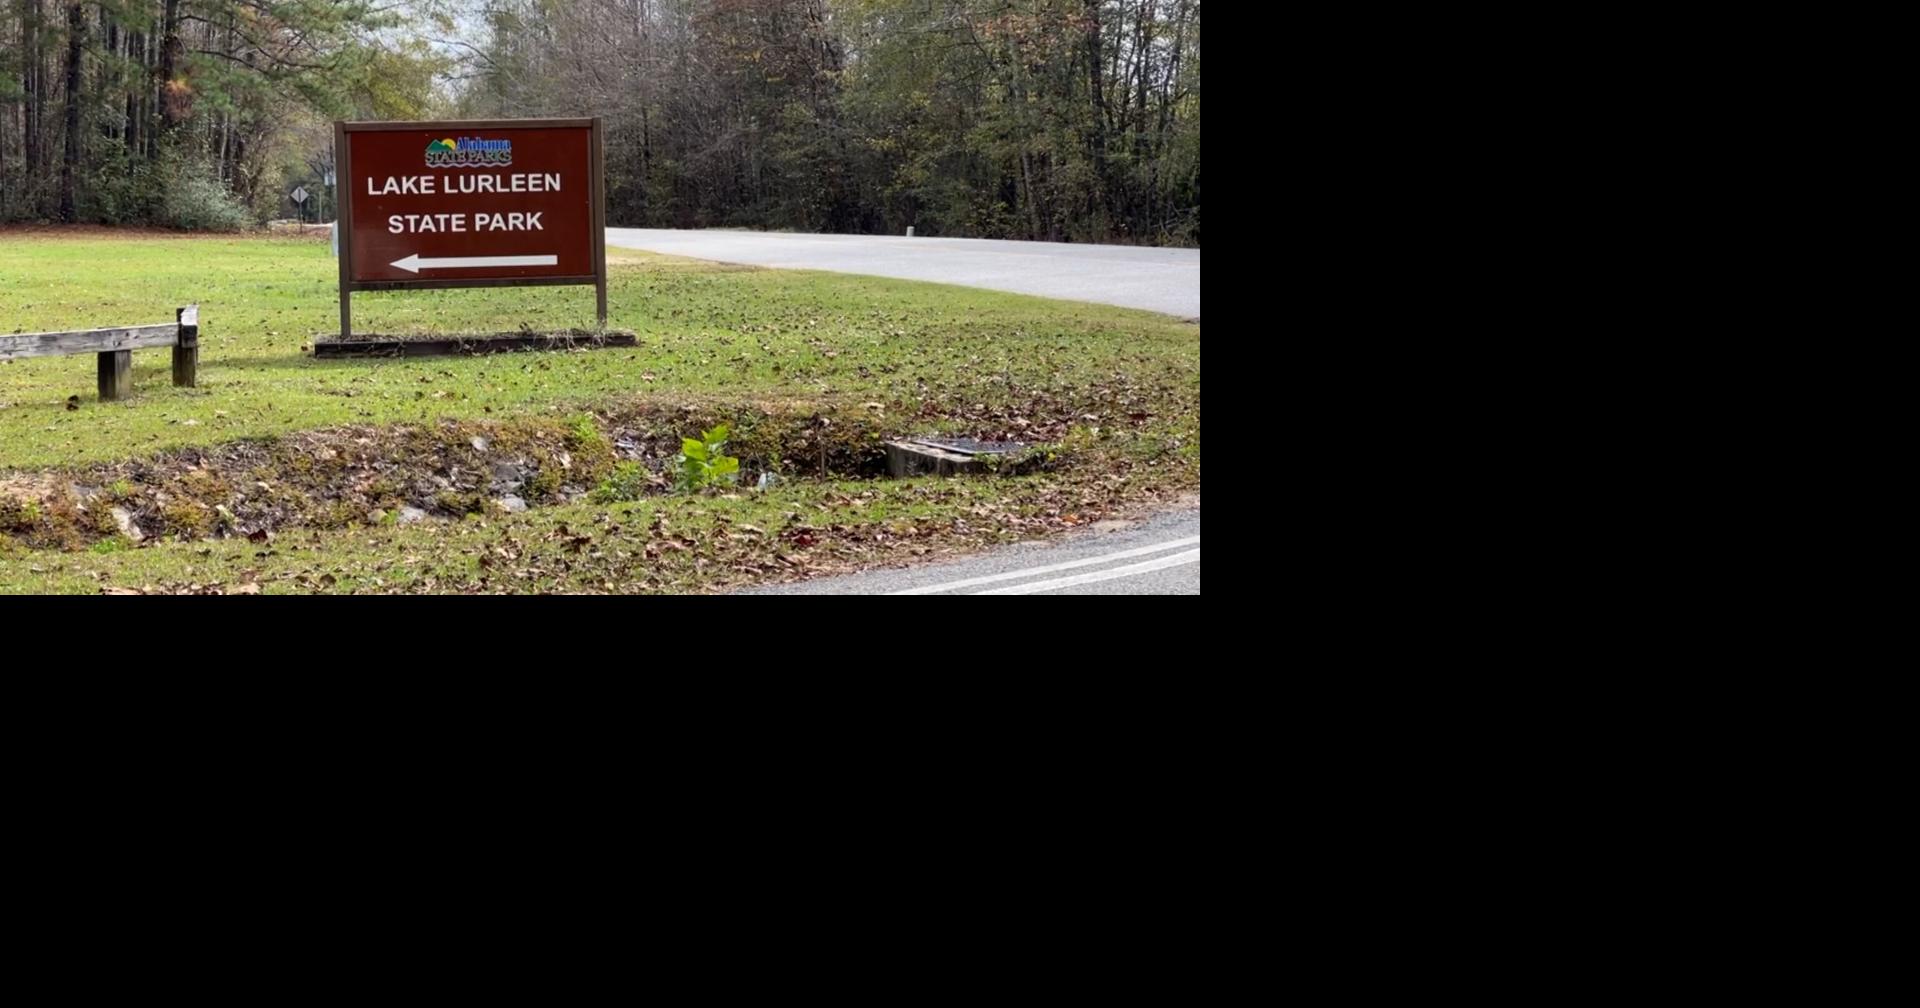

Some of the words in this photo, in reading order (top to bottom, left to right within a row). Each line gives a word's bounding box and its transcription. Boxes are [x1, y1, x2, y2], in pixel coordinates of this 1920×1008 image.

[456, 137, 512, 151] Alabama
[425, 150, 466, 163] STATE
[468, 149, 512, 162] PARKS
[368, 176, 435, 195] LAKE
[443, 173, 561, 193] LURLEEN
[388, 213, 466, 234] STATE
[475, 212, 543, 231] PARK
